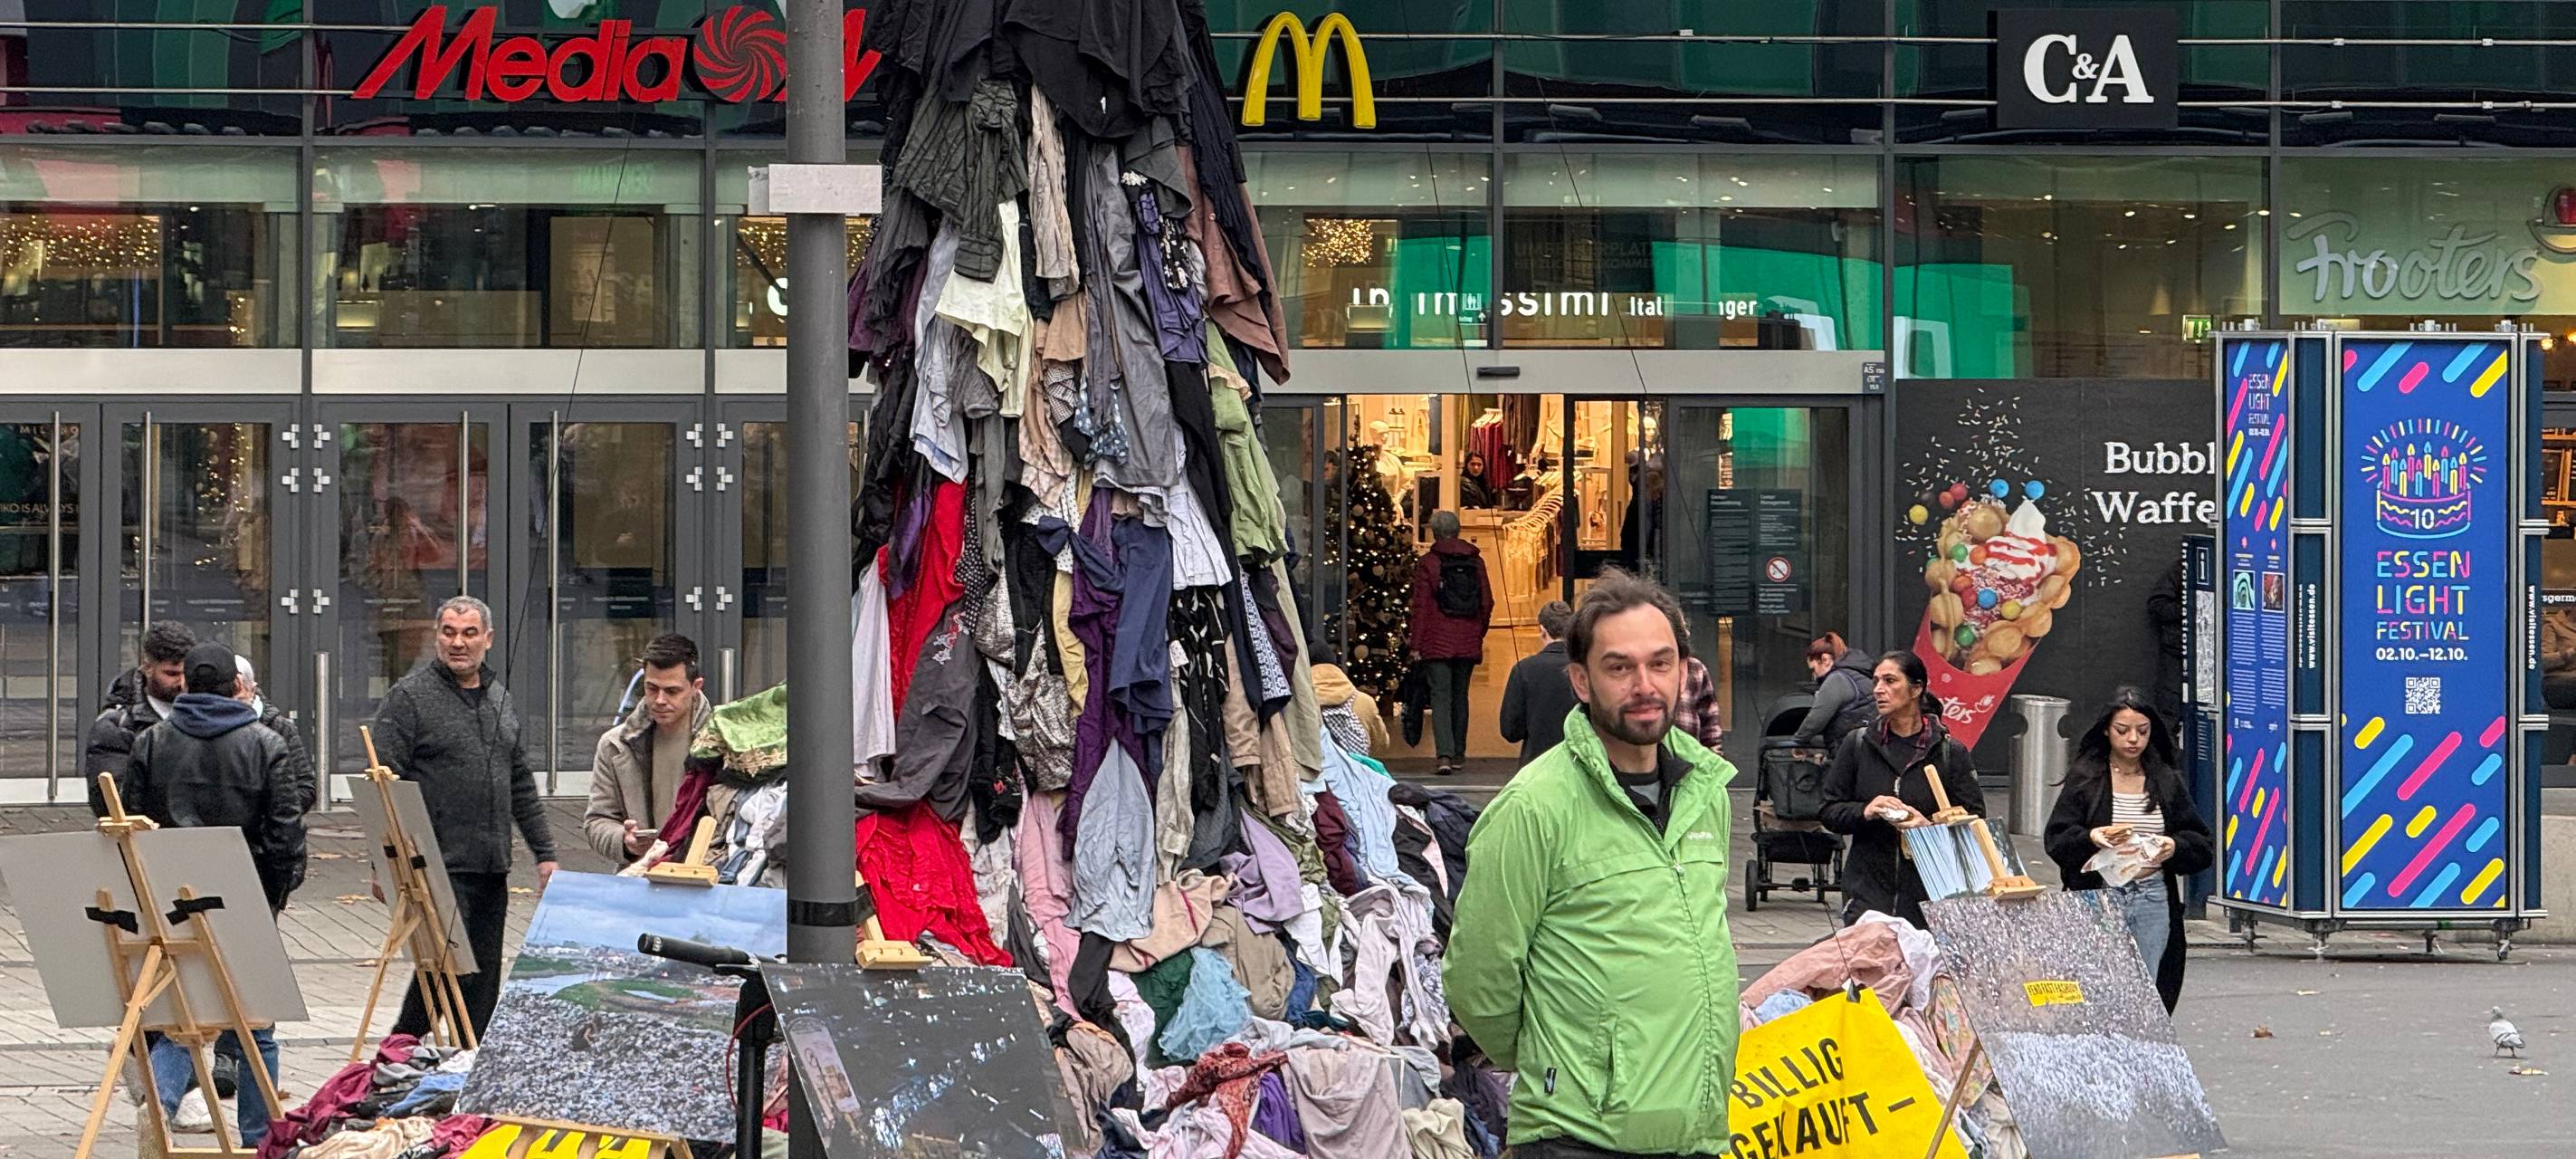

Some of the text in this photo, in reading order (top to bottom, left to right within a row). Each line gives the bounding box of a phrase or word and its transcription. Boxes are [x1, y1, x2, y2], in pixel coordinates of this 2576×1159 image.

[352, 5, 689, 102] Media
[2023, 34, 2155, 104] C&A
[1630, 296, 1663, 317] Ital
[19, 426, 79, 435] MILNO
[2104, 442, 2216, 474] Bubbl
[0, 503, 18, 513] IKO
[2090, 491, 2216, 523] Waffe
[2410, 508, 2435, 530] 10
[2377, 551, 2470, 579] ESSEN
[2377, 585, 2470, 615] LIGHT
[2307, 584, 2315, 668] www.visitessen.de
[2377, 621, 2469, 640] FESTIVAL
[2528, 585, 2536, 670] www.visitessen.de
[1730, 1037, 1845, 1110] BILLIG
